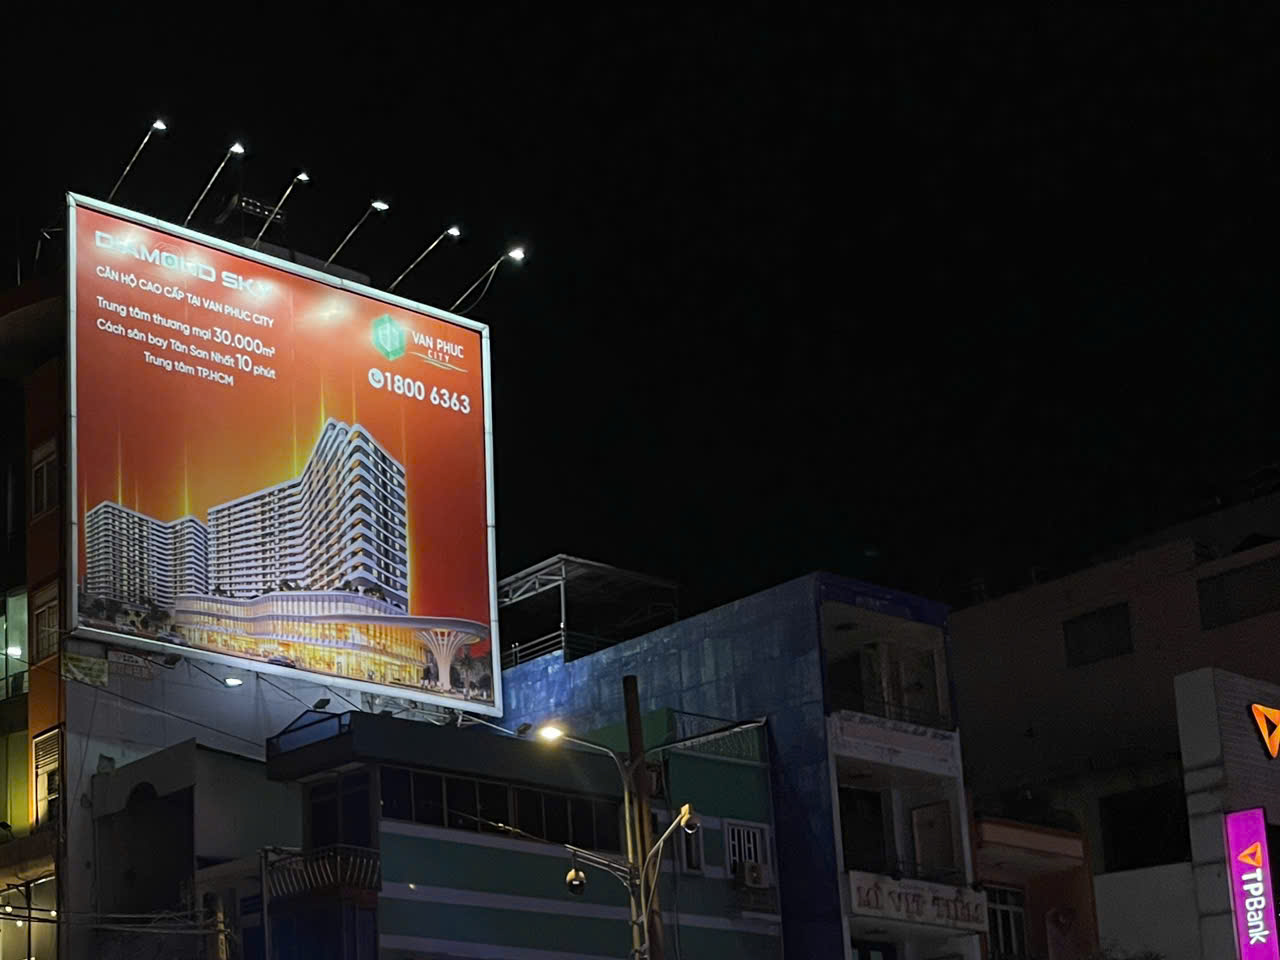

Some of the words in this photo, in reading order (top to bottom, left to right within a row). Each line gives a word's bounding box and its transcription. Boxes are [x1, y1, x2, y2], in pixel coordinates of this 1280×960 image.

[96, 295, 127, 317] Trung
[129, 306, 151, 322] tâm
[192, 325, 212, 340] mại
[121, 274, 137, 288] HỘ
[139, 280, 162, 294] CAO
[186, 293, 201, 307] TẠI
[253, 313, 275, 329] CITY
[96, 319, 126, 337] Cách
[127, 328, 147, 342] sân
[147, 332, 169, 350] bay
[169, 338, 189, 353] Tân
[210, 350, 235, 368] Nhất
[235, 354, 252, 372] 10
[253, 364, 276, 379] phút
[411, 330, 433, 349] VAN
[436, 338, 464, 359] PHUC
[427, 349, 450, 363] CITY
[143, 351, 173, 371] Trung
[174, 360, 195, 376] tâm
[196, 366, 235, 387] TP.HCM
[384, 371, 425, 401] 1800
[430, 386, 471, 414] 6363
[1241, 868, 1270, 945] TPBank
